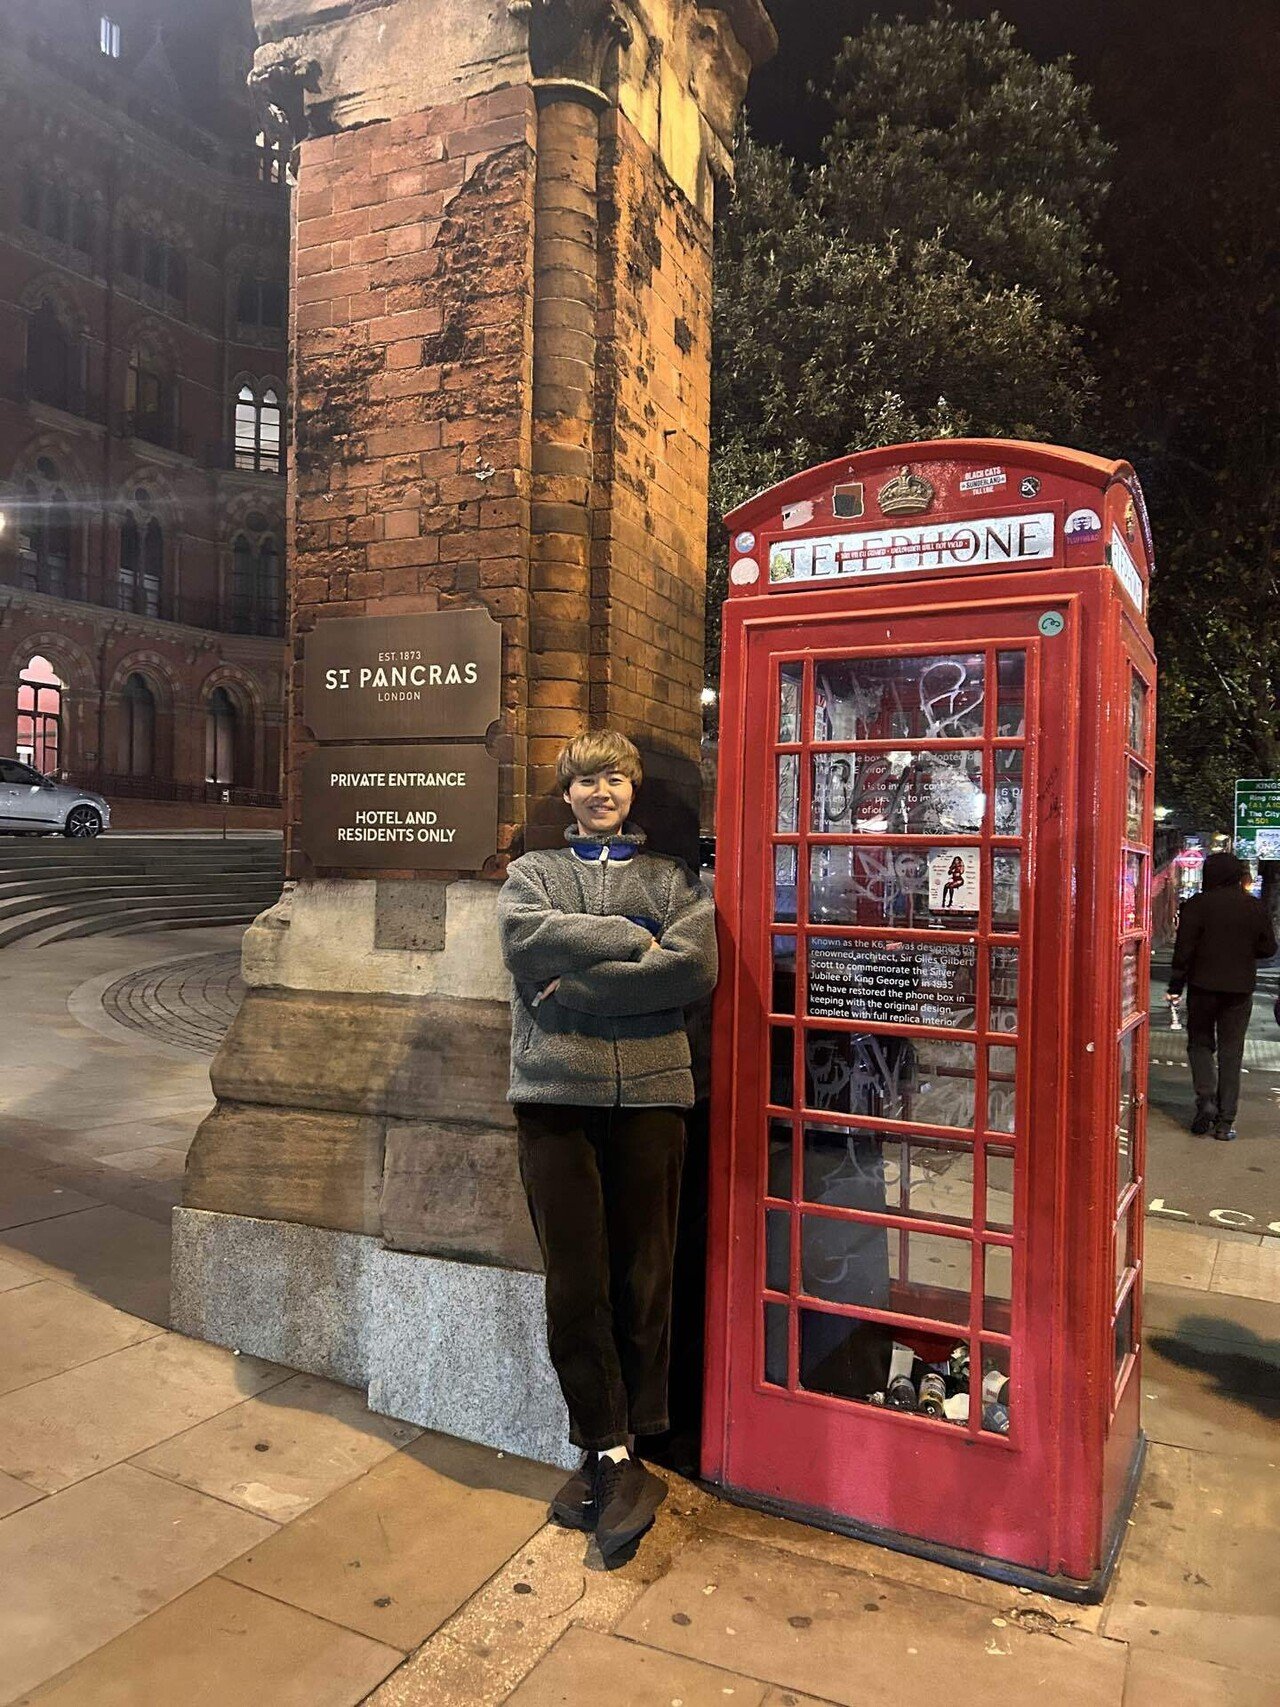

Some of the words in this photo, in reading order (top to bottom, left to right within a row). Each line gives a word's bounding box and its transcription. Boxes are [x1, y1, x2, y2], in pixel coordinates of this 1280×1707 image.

[965, 471, 985, 480] BLACK
[985, 467, 1001, 476] CATS
[966, 476, 1001, 489] SUNDERLAND
[780, 520, 1042, 577] TELEPHONE
[378, 652, 398, 662] EST.
[400, 650, 421, 661] 1873
[360, 662, 478, 688] PANCRAS
[378, 691, 421, 702] LONDON
[330, 773, 385, 787] PRIVATE
[388, 772, 466, 787] ENTRANCE
[907, 794, 918, 803] to
[355, 811, 402, 825] HOTEL
[405, 811, 437, 824] AND
[337, 828, 414, 842] RESIDENTS
[417, 828, 456, 843] ONLY
[811, 937, 841, 946] Known
[855, 939, 869, 948] the
[811, 949, 854, 959] renowned
[900, 954, 913, 962] Sir
[940, 956, 974, 967] Gilbert
[811, 960, 834, 969] Scott
[836, 961, 845, 970] to
[846, 963, 910, 975] commemorate
[912, 965, 927, 975] the
[929, 967, 956, 978] Silver
[810, 972, 841, 982] Jubilee
[842, 972, 852, 982] of
[854, 974, 874, 986] King
[876, 976, 910, 988] George
[912, 978, 919, 987] V
[811, 982, 825, 992] We
[826, 983, 847, 994] have
[849, 986, 886, 997] restored
[888, 989, 903, 999] the
[905, 991, 934, 1003] phone
[936, 993, 954, 1002] box
[956, 994, 965, 1003] in
[810, 995, 844, 1007] keeping
[846, 997, 865, 1007] with
[867, 999, 882, 1009] the
[884, 1000, 918, 1013] original
[810, 1007, 850, 1020] complete
[851, 1009, 871, 1019] with
[873, 1010, 888, 1021] full
[889, 1012, 920, 1025] replica
[922, 1015, 956, 1027] interior
